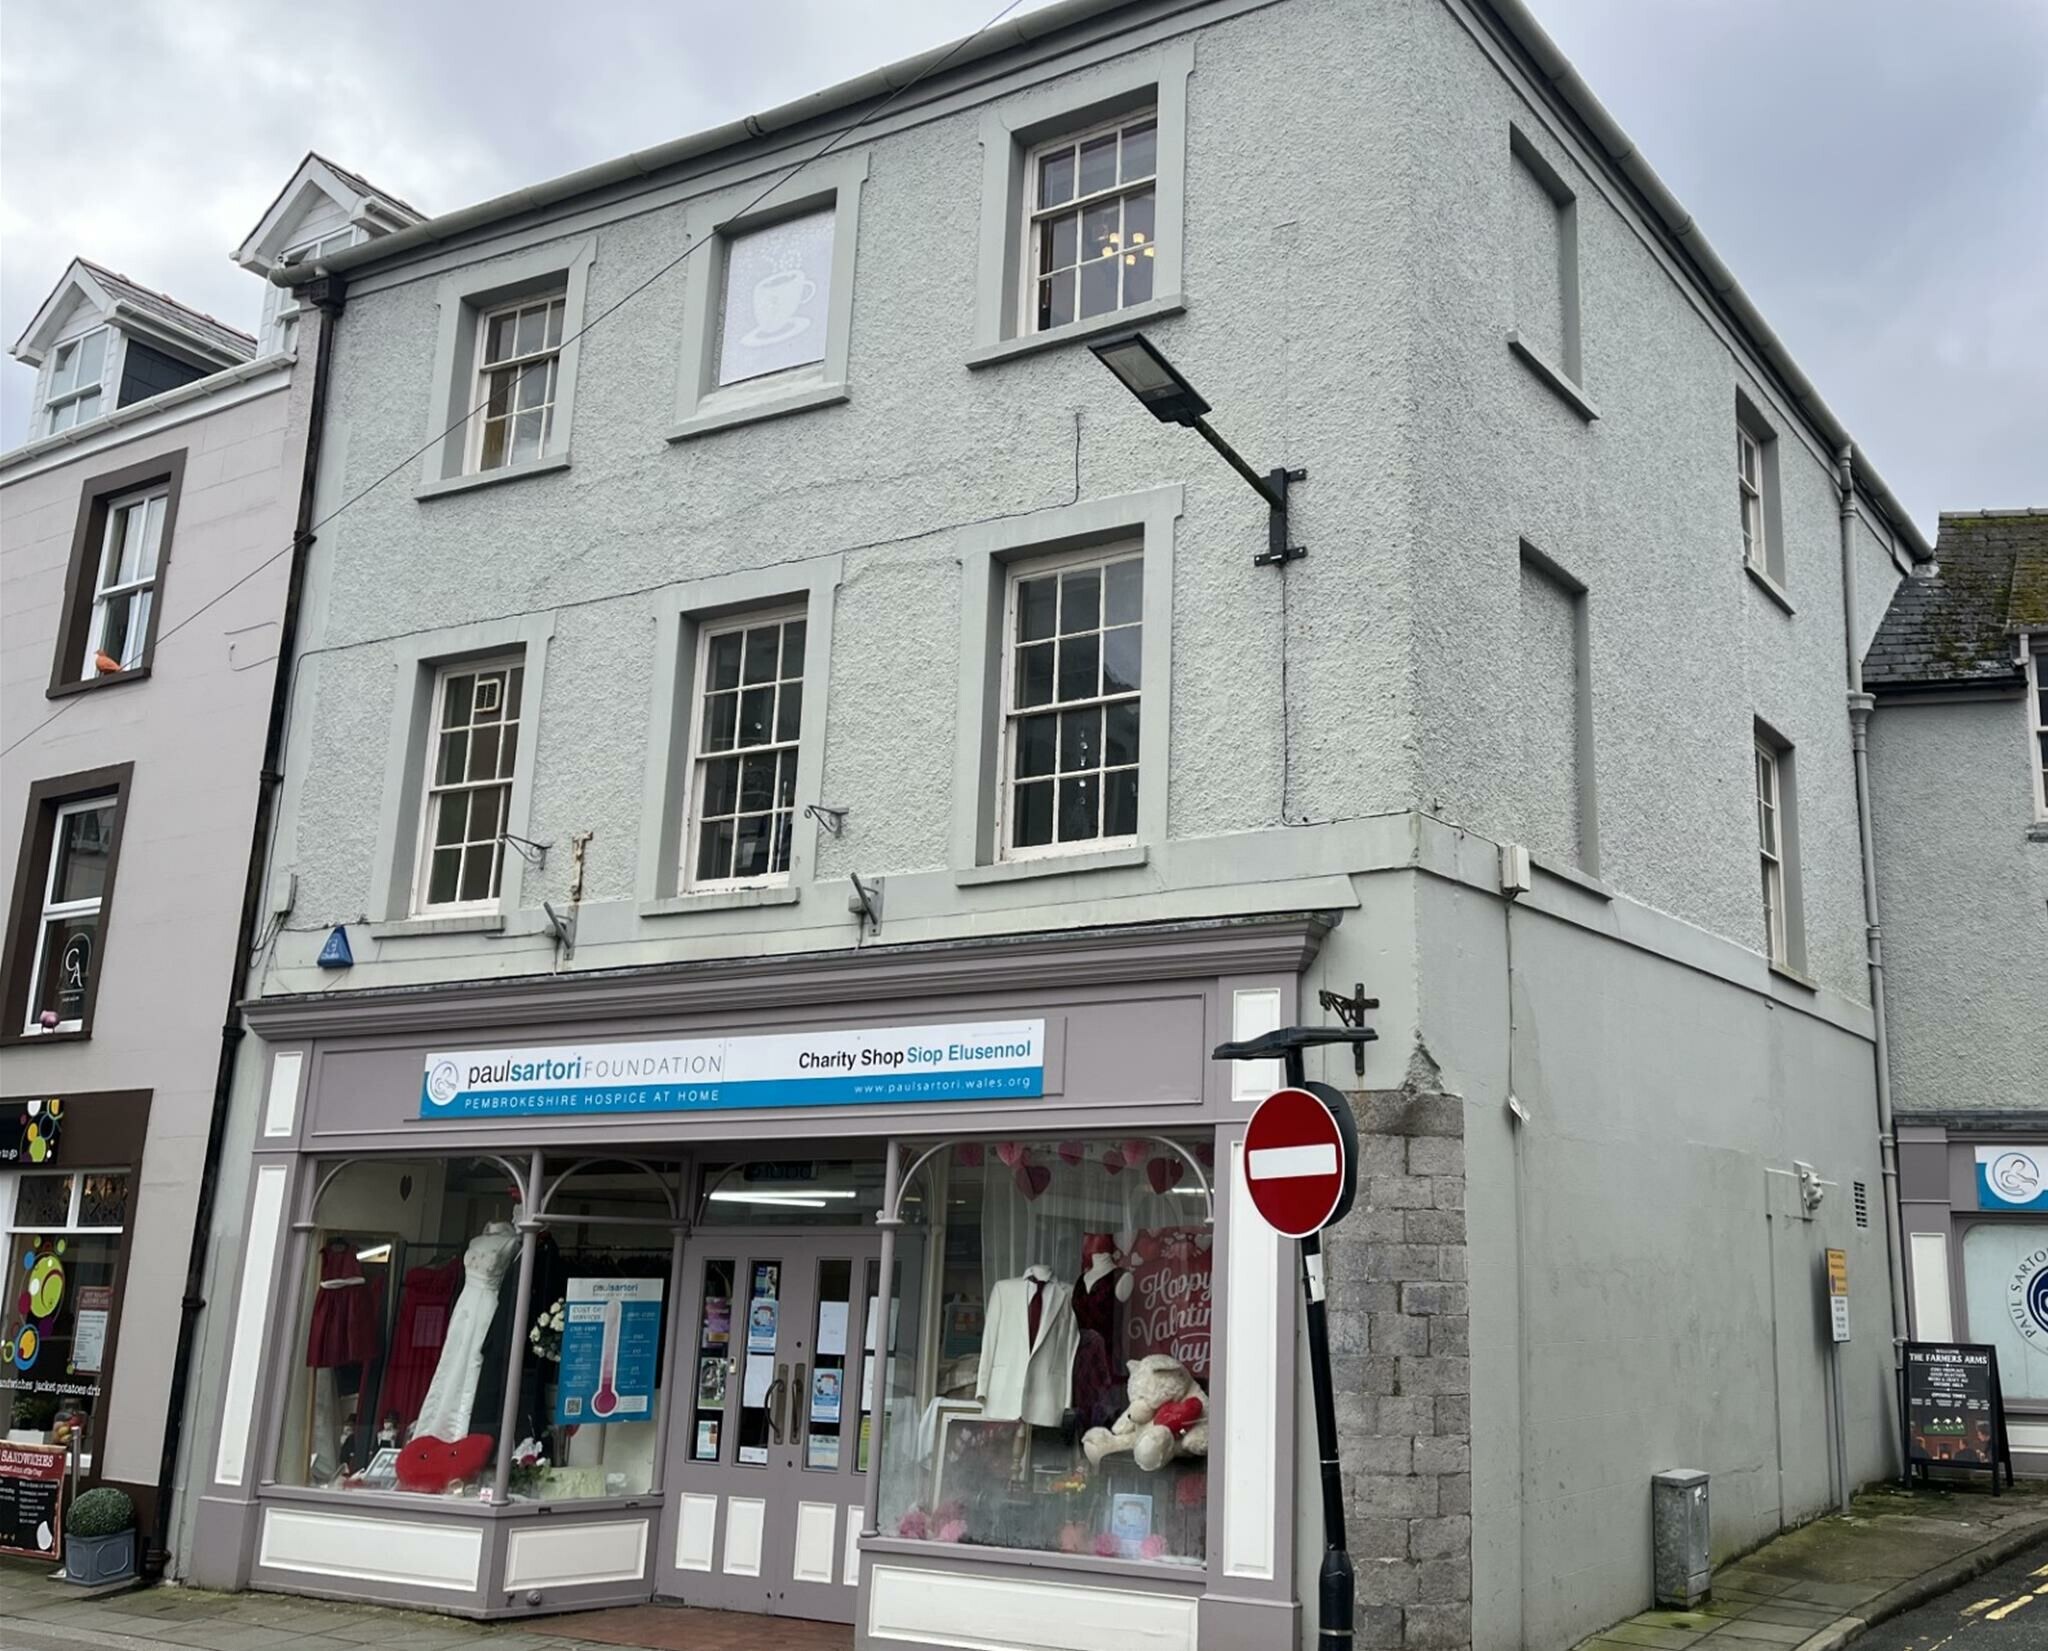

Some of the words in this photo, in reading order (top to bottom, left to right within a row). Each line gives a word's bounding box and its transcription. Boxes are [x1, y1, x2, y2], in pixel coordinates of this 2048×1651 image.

[799, 1051, 857, 1071] Charity
[861, 1048, 905, 1067] Shop
[907, 1046, 943, 1066] Siop
[949, 1040, 1031, 1061] Elusennol
[467, 1056, 582, 1089] paulsartori
[584, 1055, 723, 1079] FOUNDATION
[465, 1094, 578, 1109] PEMBROKESHIRE
[585, 1092, 647, 1105] HOSPICE
[653, 1091, 671, 1102] AT
[678, 1090, 719, 1102] HOME
[2010, 1249, 2048, 1293] SARTO
[2011, 1299, 2037, 1339] PAUL
[1909, 1353, 1924, 1361] THE
[1925, 1354, 1963, 1362] FARMERS
[1964, 1355, 1988, 1364] ARMS
[1, 1450, 54, 1468] SANDWICHES
